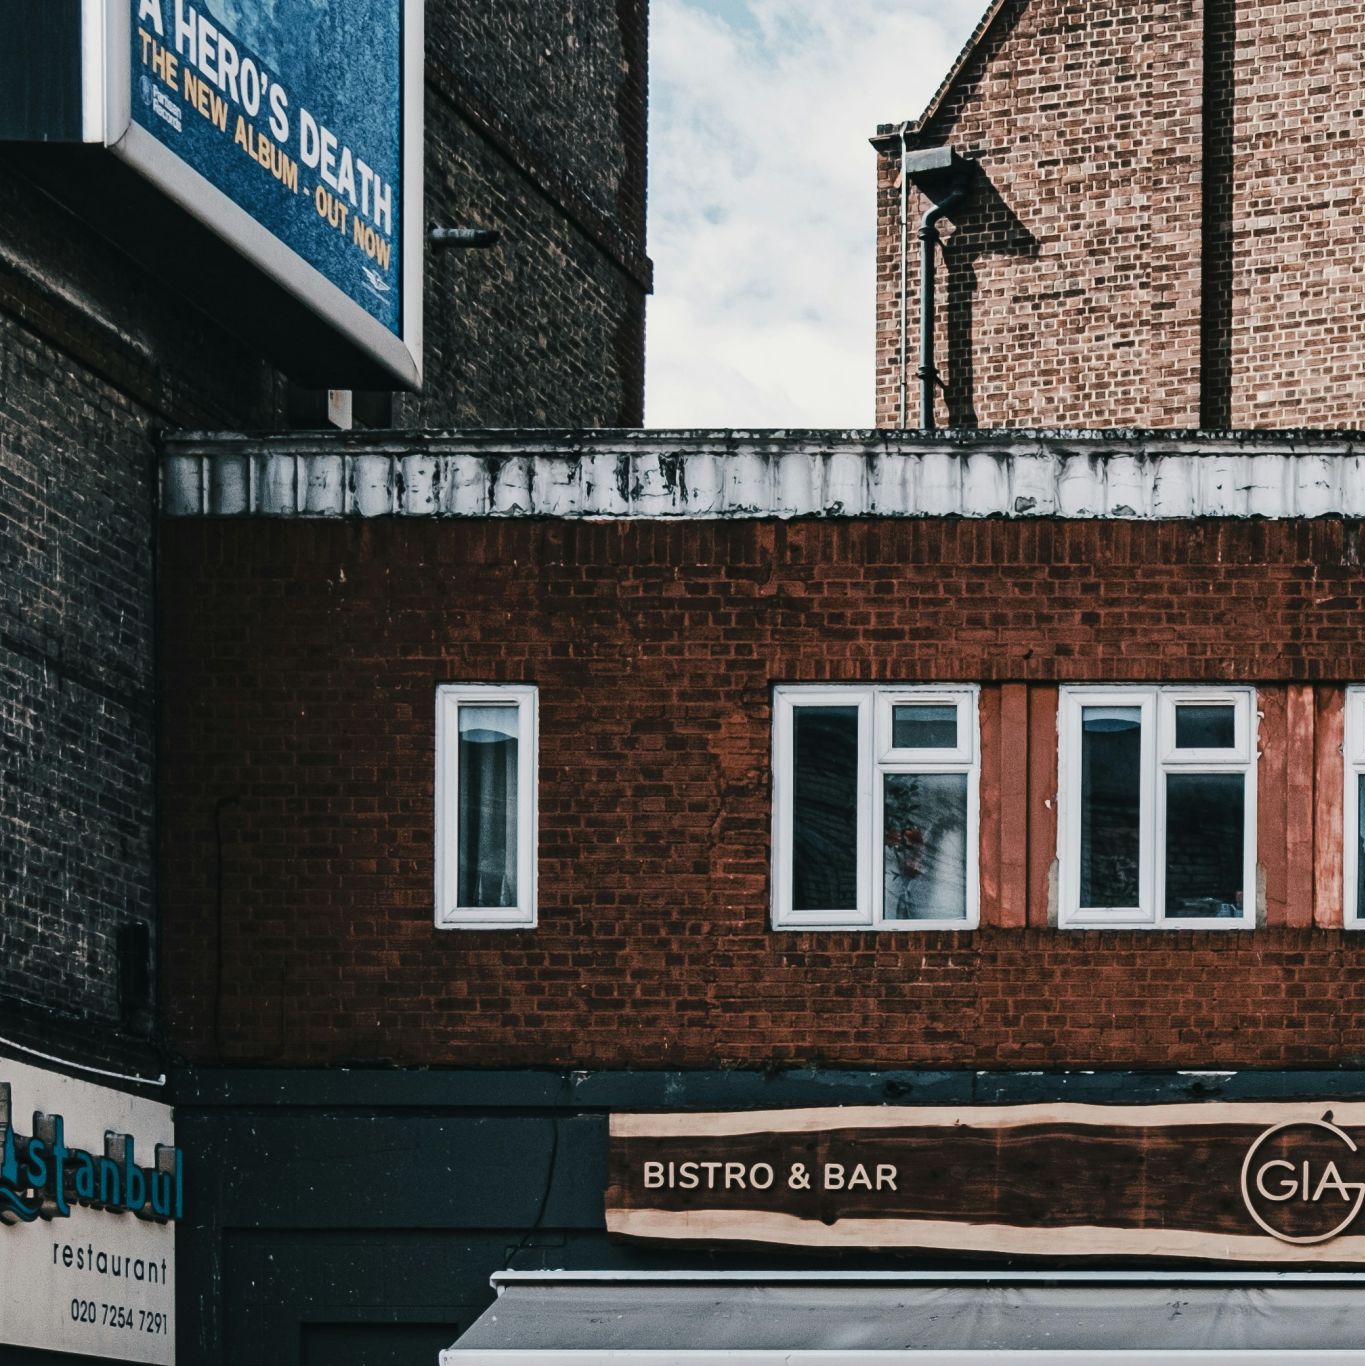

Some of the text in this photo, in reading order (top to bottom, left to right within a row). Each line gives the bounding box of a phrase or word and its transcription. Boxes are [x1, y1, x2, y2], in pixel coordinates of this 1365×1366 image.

[174, 0, 289, 143] HERO'S
[300, 108, 392, 236] DEATH
[138, 27, 179, 92] THE
[184, 68, 229, 133] NEW
[234, 115, 298, 194] ALBUM
[315, 185, 349, 235] OUT
[354, 216, 391, 271] NOW
[643, 1161, 899, 1192] BISTRO & BAR
[1256, 1158, 1350, 1202] GIA
[53, 1242, 167, 1285] restaurant
[71, 1299, 167, 1335] 020 7254 7291
